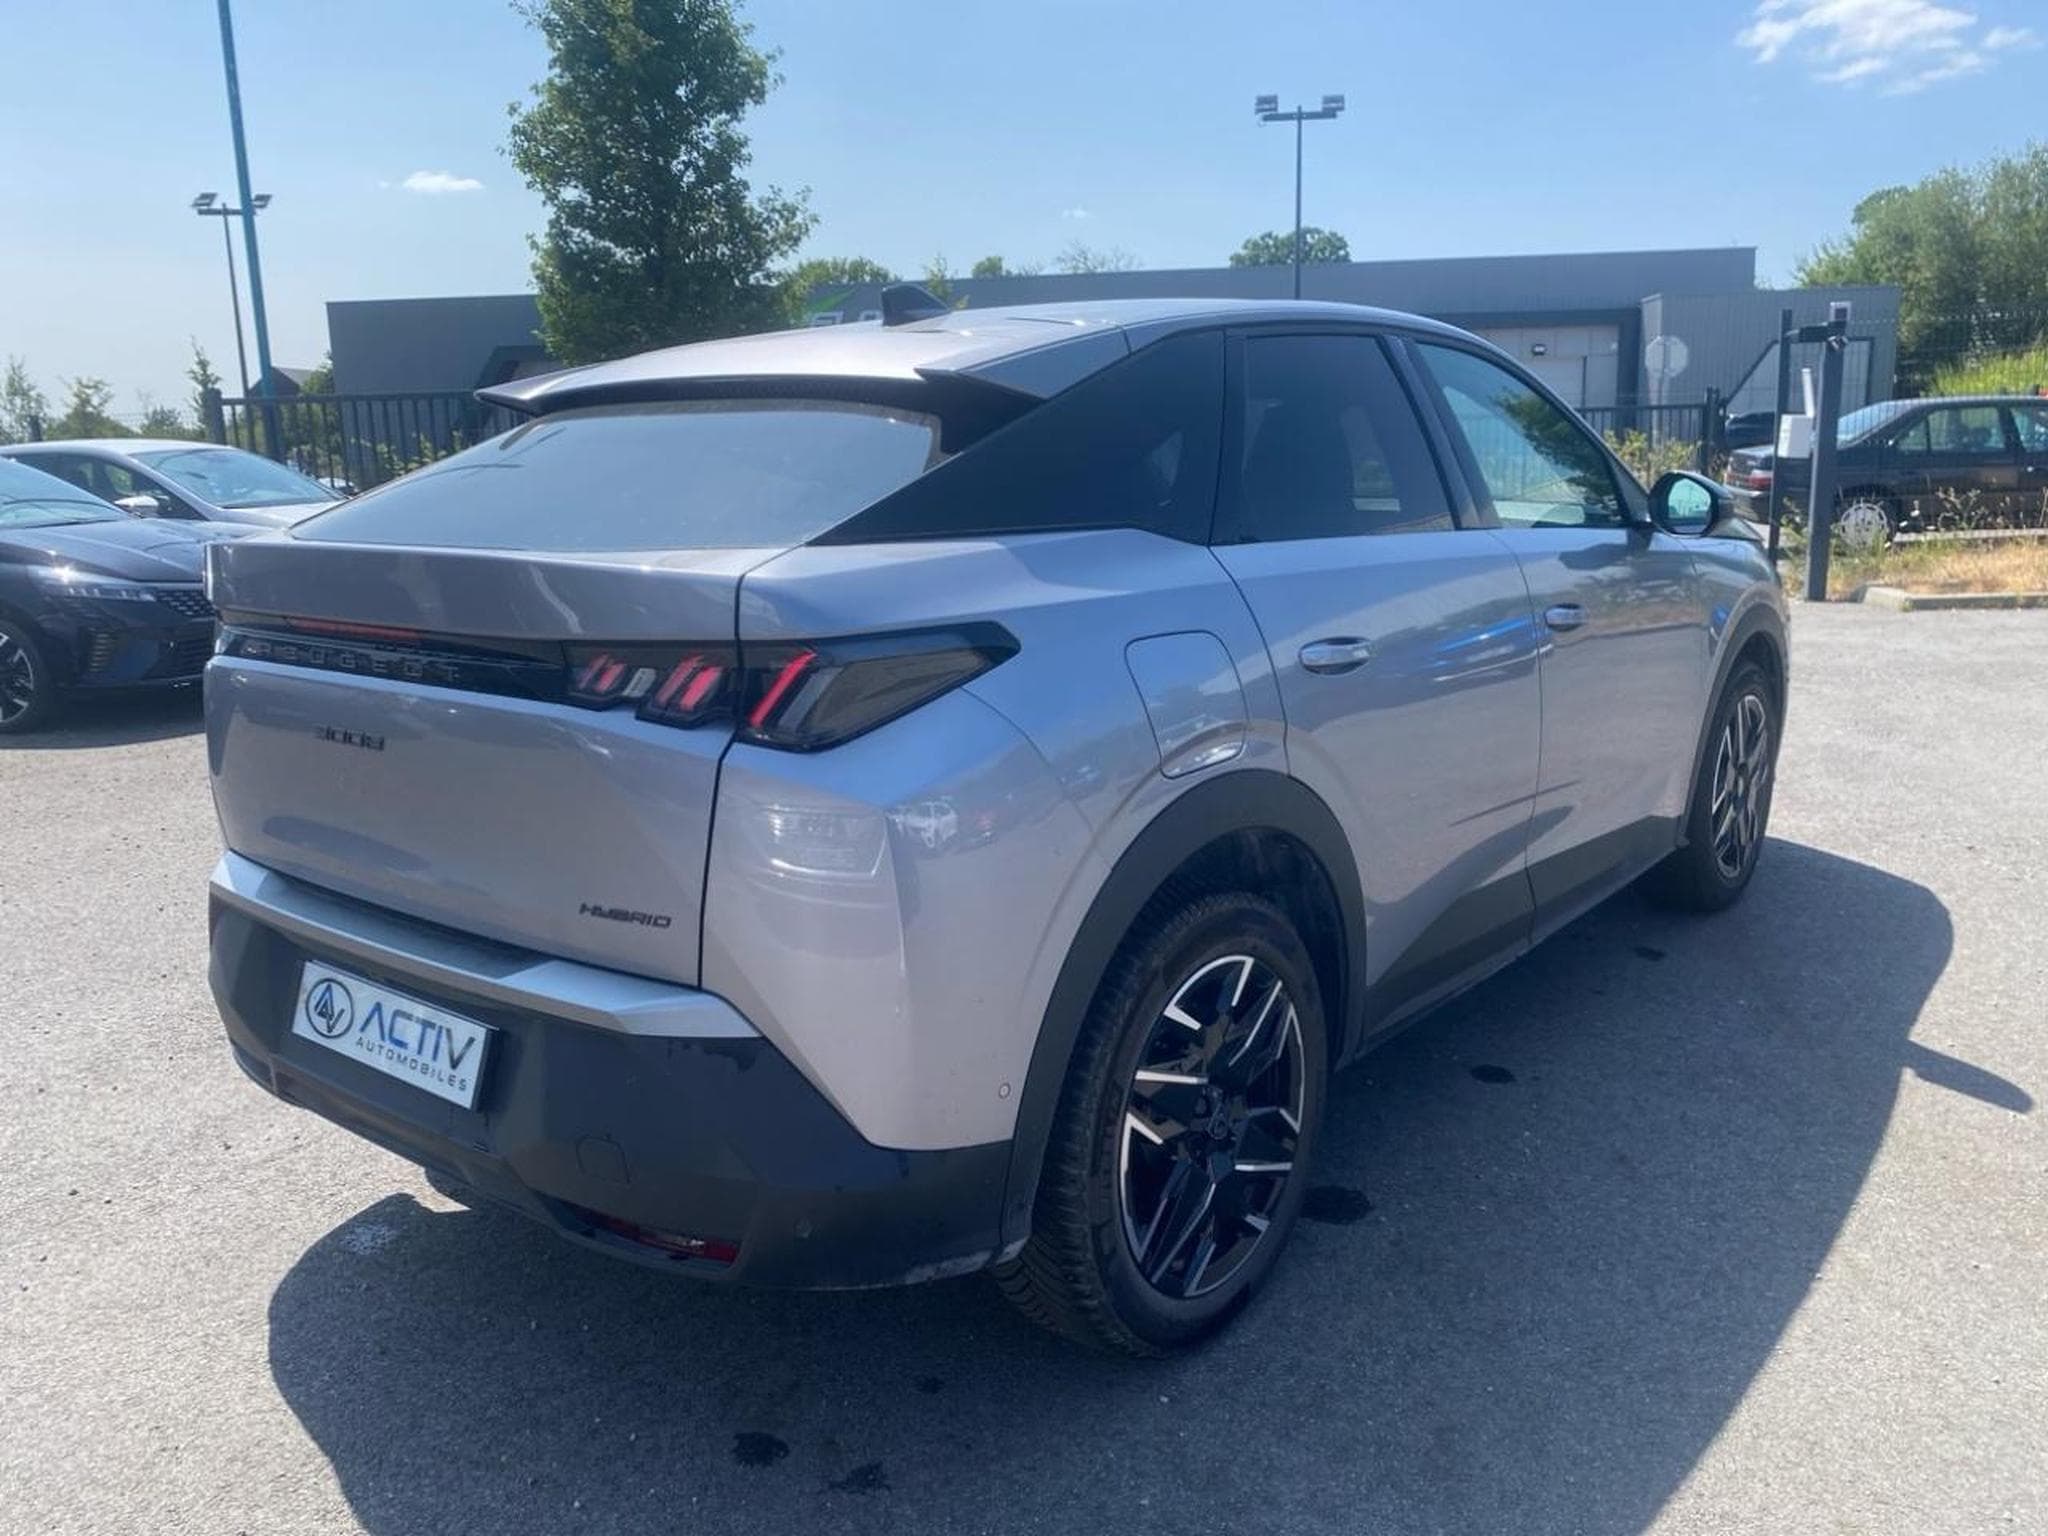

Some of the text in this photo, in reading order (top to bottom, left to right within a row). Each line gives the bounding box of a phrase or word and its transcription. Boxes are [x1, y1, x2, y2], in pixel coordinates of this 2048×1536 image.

[315, 726, 385, 752] 3008
[579, 902, 672, 929] HYBRID
[359, 1001, 476, 1070] ACTIV
[355, 1036, 467, 1091] AUTOMOBILES
